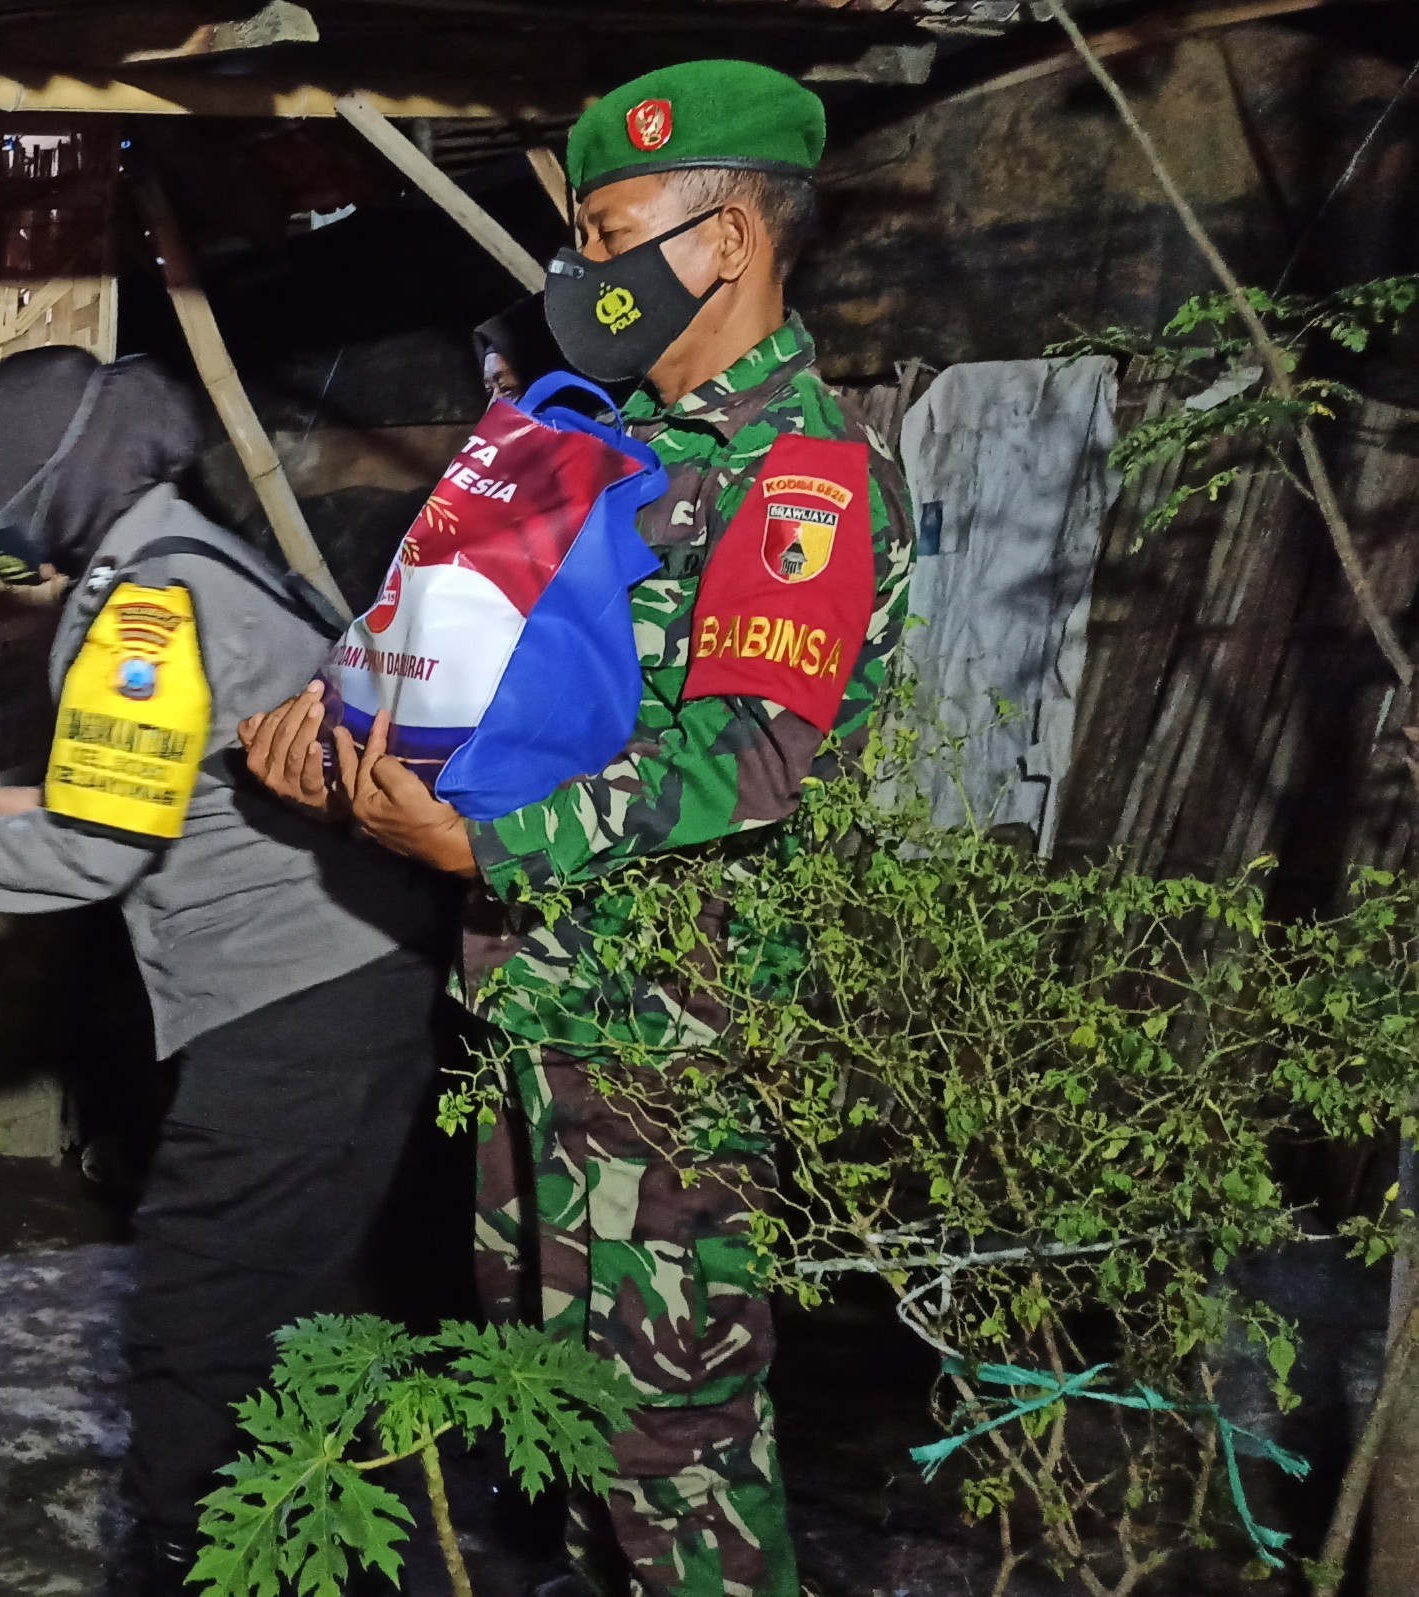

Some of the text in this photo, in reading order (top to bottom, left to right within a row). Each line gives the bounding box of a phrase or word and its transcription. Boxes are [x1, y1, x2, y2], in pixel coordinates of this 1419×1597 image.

[609, 307, 642, 335] POLRI
[770, 505, 835, 526] BRAWIJAYA
[695, 615, 842, 684] BABINSA
